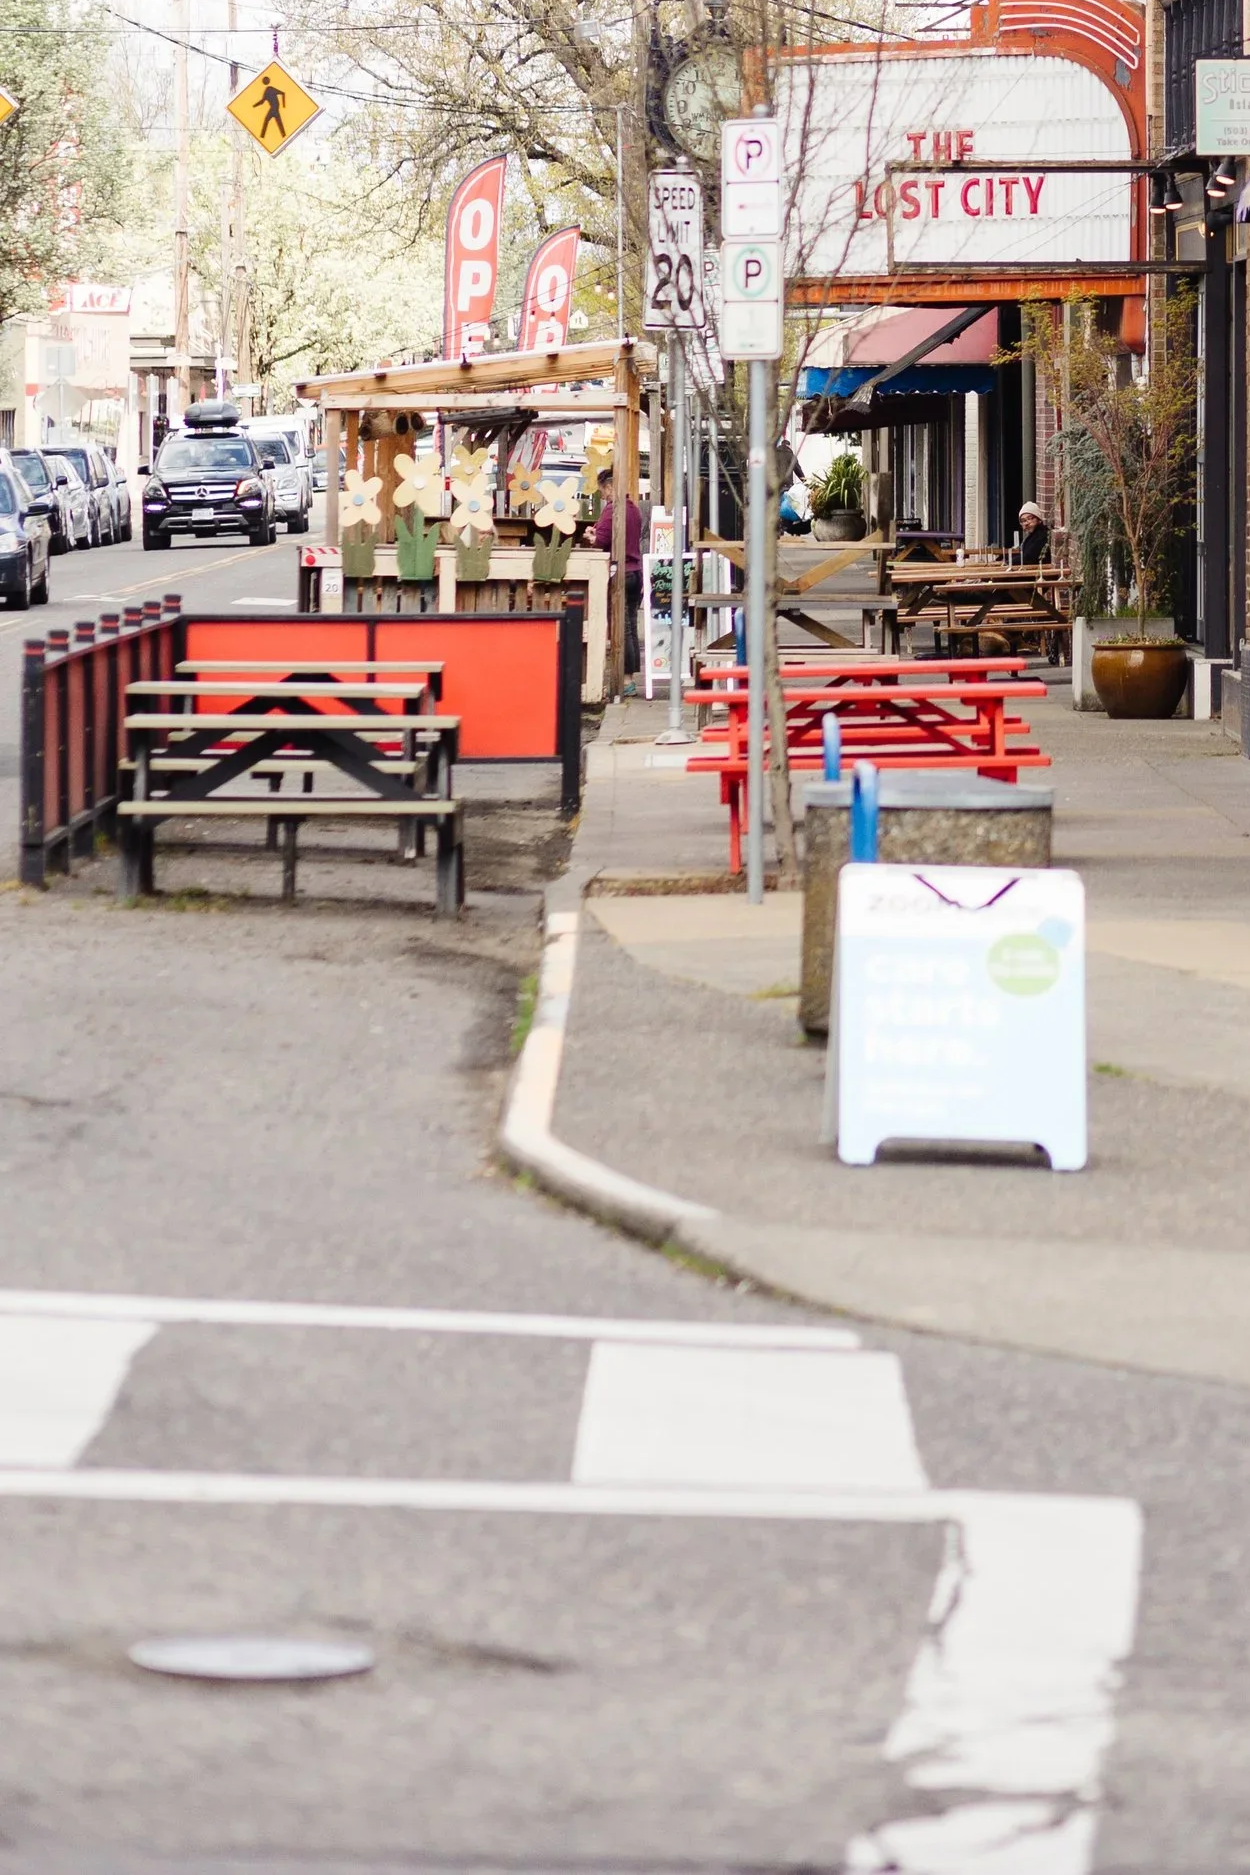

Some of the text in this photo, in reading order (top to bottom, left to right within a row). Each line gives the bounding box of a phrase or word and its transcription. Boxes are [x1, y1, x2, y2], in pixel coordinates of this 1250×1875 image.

[907, 130, 974, 162] THE
[1216, 137, 1238, 146] Take
[654, 186, 696, 210] SPEED
[855, 175, 1046, 220] LOST CITY
[457, 198, 495, 359] OPE
[651, 253, 695, 312] 20
[82, 291, 122, 308] ACE
